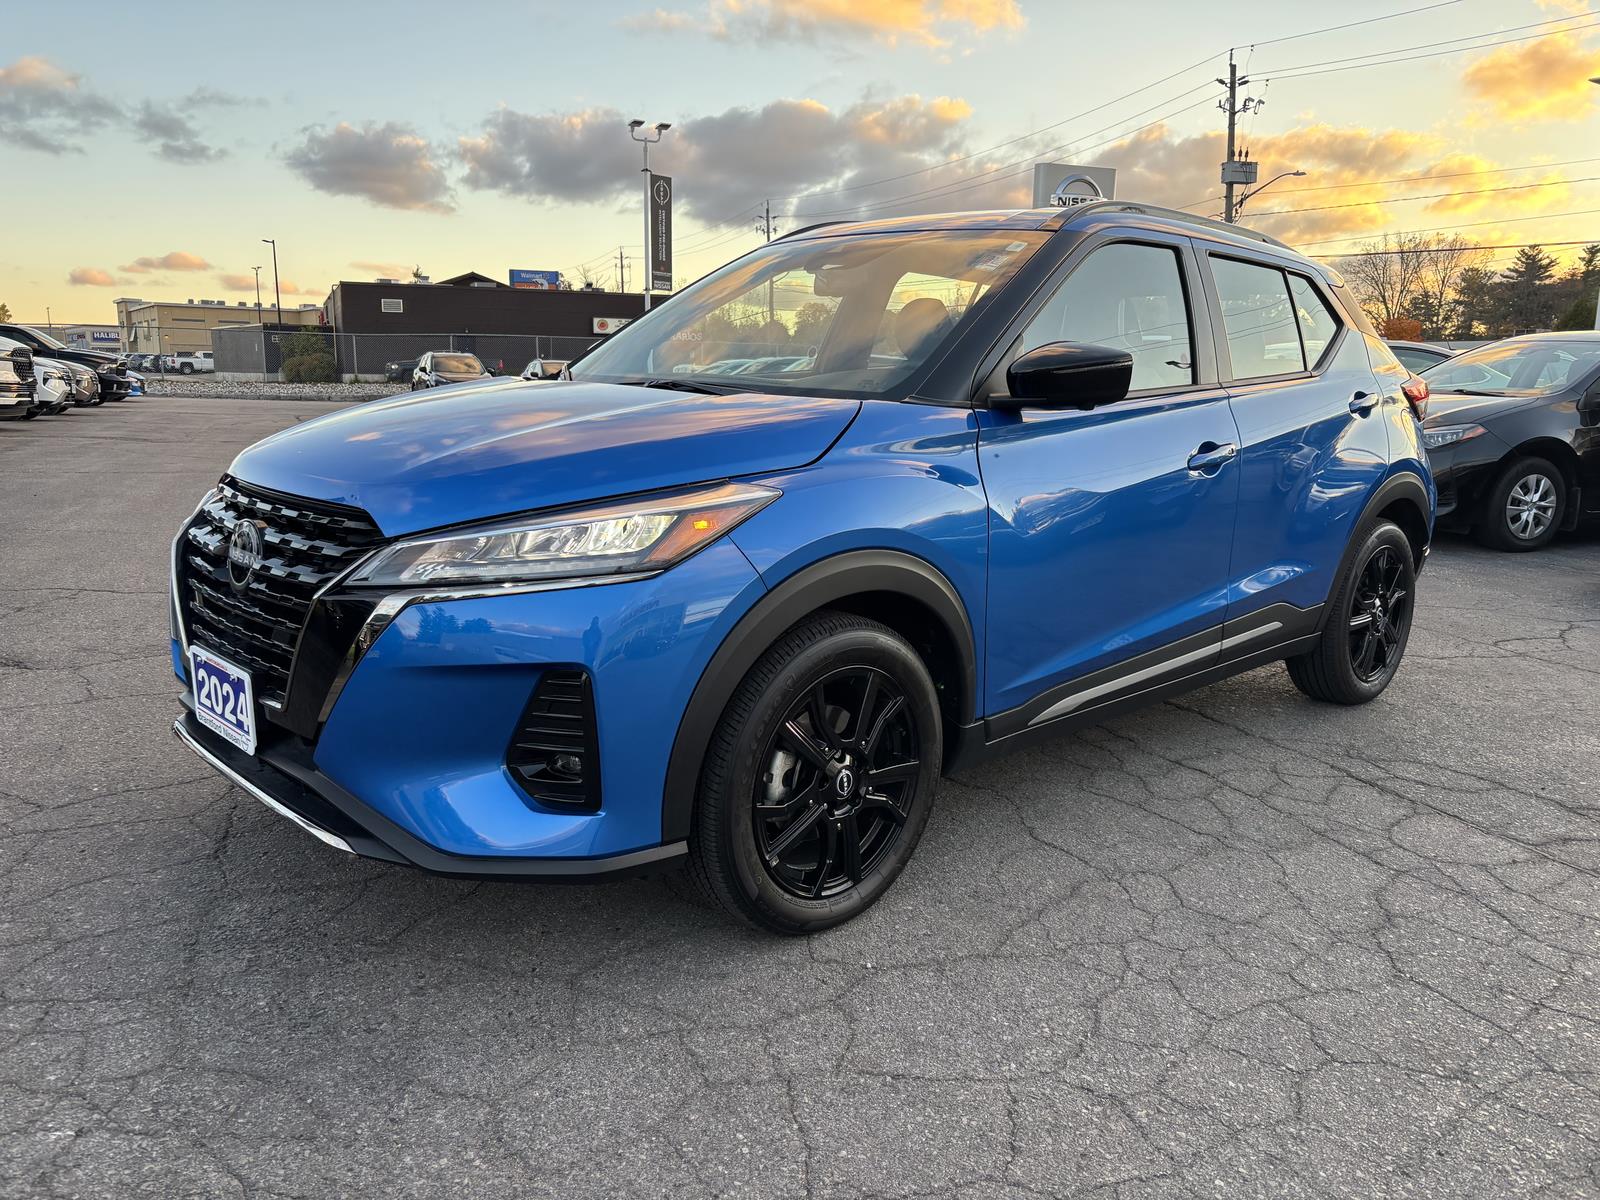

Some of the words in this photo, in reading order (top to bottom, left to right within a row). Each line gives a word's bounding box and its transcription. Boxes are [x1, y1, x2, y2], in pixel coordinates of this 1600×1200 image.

[1057, 196, 1095, 206] NISS
[197, 667, 250, 732] 2024
[198, 711, 223, 734] Brantford
[223, 726, 242, 745] Nissan
